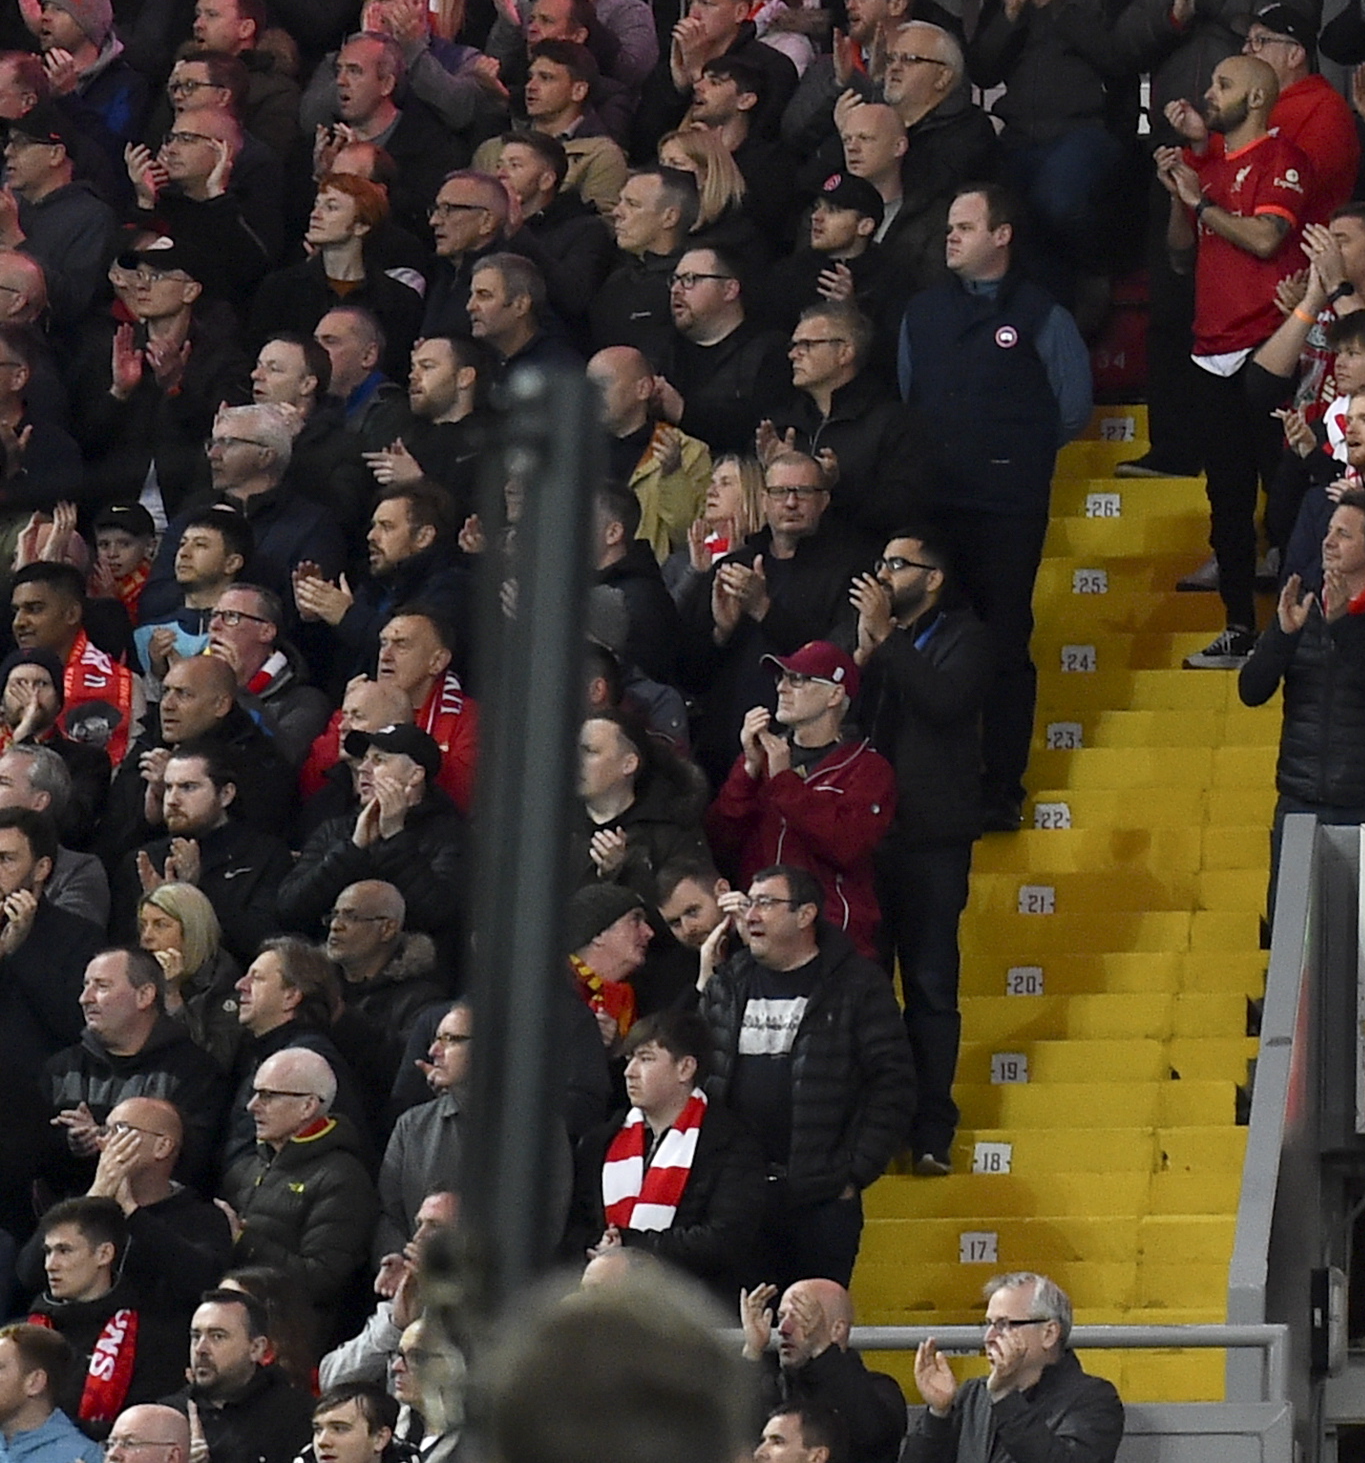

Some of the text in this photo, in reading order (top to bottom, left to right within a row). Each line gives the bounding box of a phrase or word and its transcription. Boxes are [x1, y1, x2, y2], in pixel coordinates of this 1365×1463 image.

[1106, 425, 1127, 442] 27
[1092, 500, 1115, 518] 26
[1079, 576, 1101, 594] 25
[1067, 653, 1089, 672] 24
[1053, 731, 1075, 749] 23
[1040, 811, 1064, 829] 22
[1027, 894, 1045, 913] 21
[1013, 974, 1037, 995] 20
[1000, 1061, 1018, 1082] 19
[983, 1152, 1002, 1172] 18
[969, 1240, 988, 1261] 17
